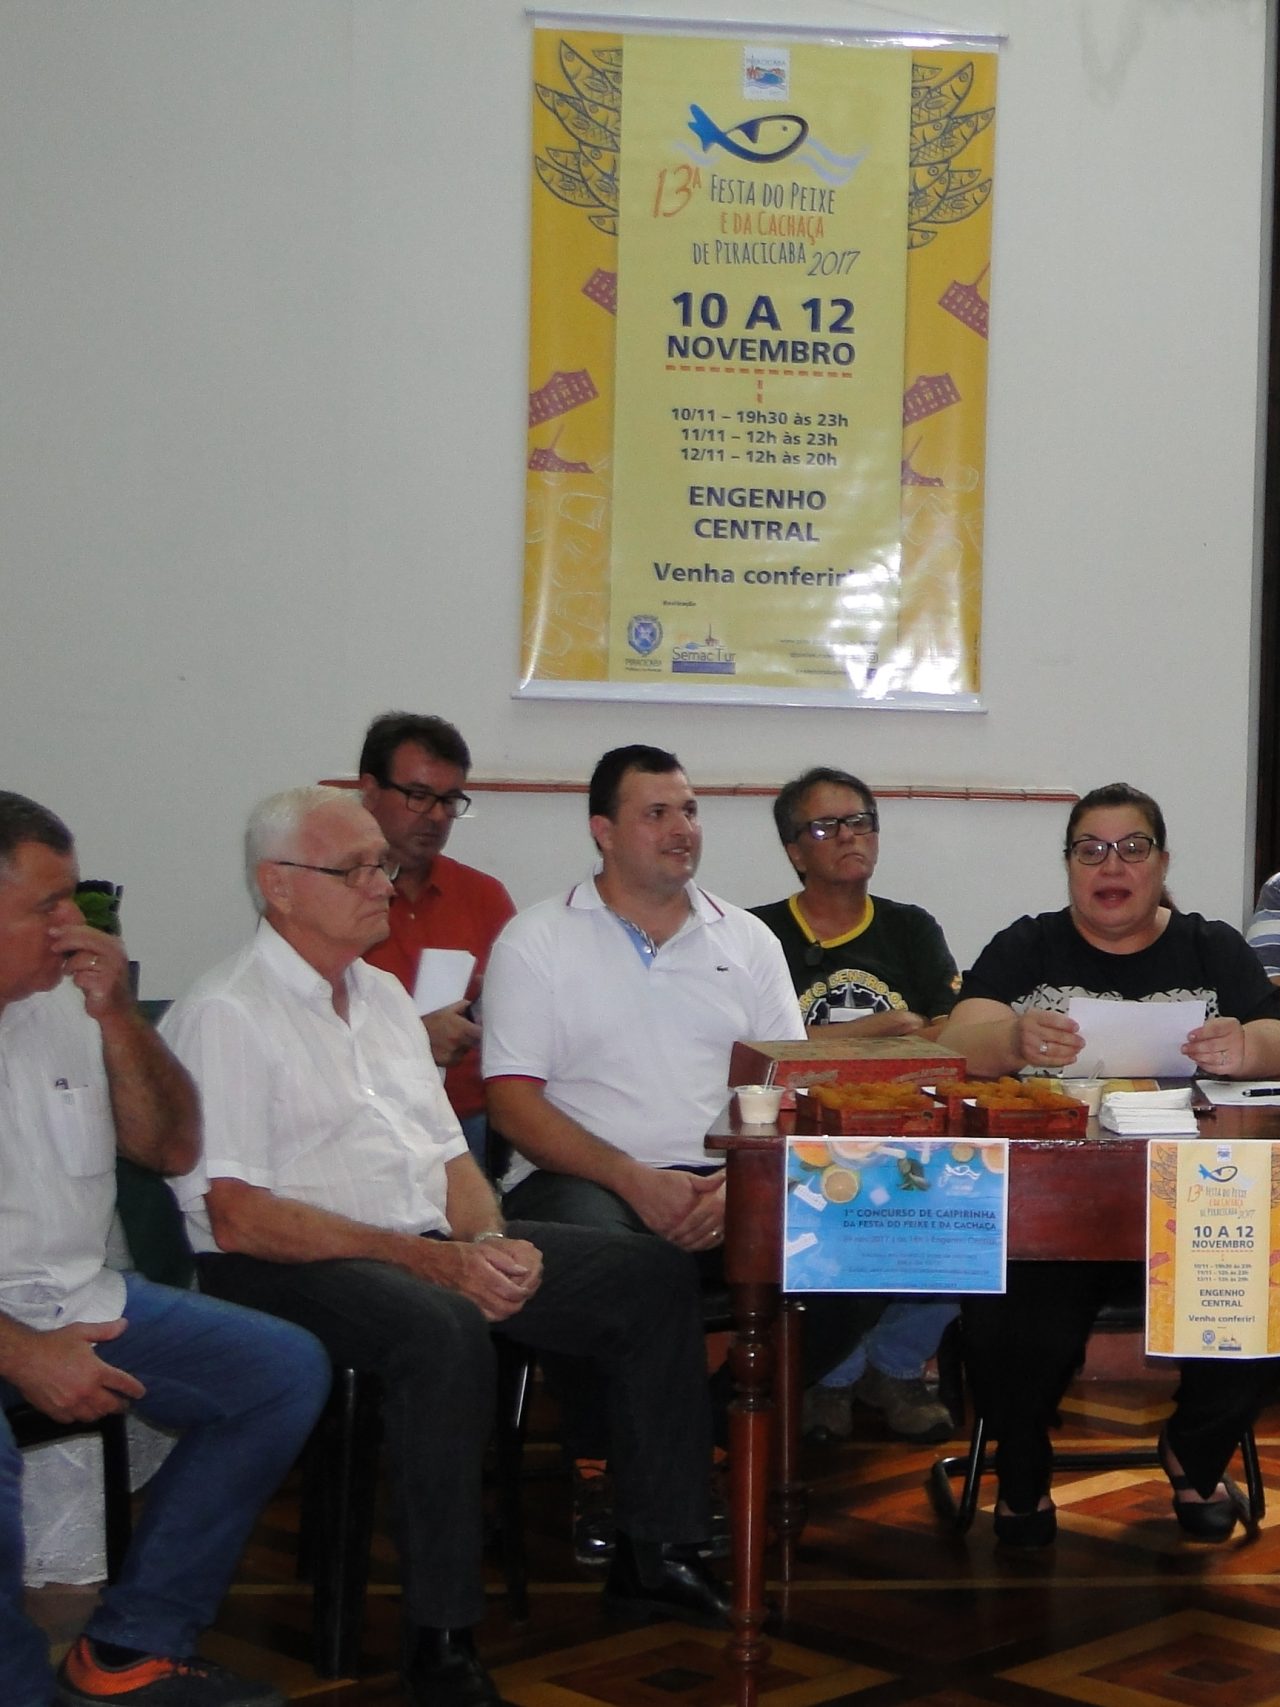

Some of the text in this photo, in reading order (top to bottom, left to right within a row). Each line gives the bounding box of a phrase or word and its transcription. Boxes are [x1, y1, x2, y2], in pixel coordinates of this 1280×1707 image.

[711, 174, 755, 206] FESTA
[762, 183, 785, 208] DO
[791, 182, 836, 214] PEIXE
[721, 211, 825, 245] E DA CACHAÇA
[693, 240, 861, 277] DE PIRACICABA 2017
[672, 292, 856, 334] 10 A 12
[667, 335, 856, 366] NOVEMBRO
[672, 408, 715, 422] 10/11
[737, 410, 788, 425] 19h30
[793, 412, 812, 426] às
[817, 413, 848, 427] 23h
[681, 428, 726, 442] 11/11
[746, 430, 777, 444] 12h
[782, 432, 801, 445] às
[806, 433, 838, 447] 23h
[681, 448, 725, 462] 12/11
[746, 450, 777, 464] 12h
[782, 451, 801, 465] às
[806, 452, 838, 467] 20h
[689, 485, 827, 510] ENGENHO
[694, 518, 820, 542] CENTRAL
[653, 562, 735, 584] Venha
[856, 1208, 916, 1218] CONCURSO
[919, 1208, 934, 1218] DE
[936, 1209, 997, 1219] CAIPIRINHA
[843, 1220, 856, 1229] DA
[859, 1221, 884, 1229] FESTA
[887, 1221, 901, 1229] DO
[931, 1221, 936, 1229] E
[939, 1221, 950, 1229] DA
[953, 1222, 997, 1231] CACHAÇA
[1193, 1226, 1254, 1238] 10 A 12
[1192, 1239, 1255, 1249] NOVEMBRO
[1200, 1289, 1246, 1297] ENGENHO
[1201, 1299, 1243, 1308] CENTRAL
[1188, 1314, 1256, 1323] Venha conferir!
